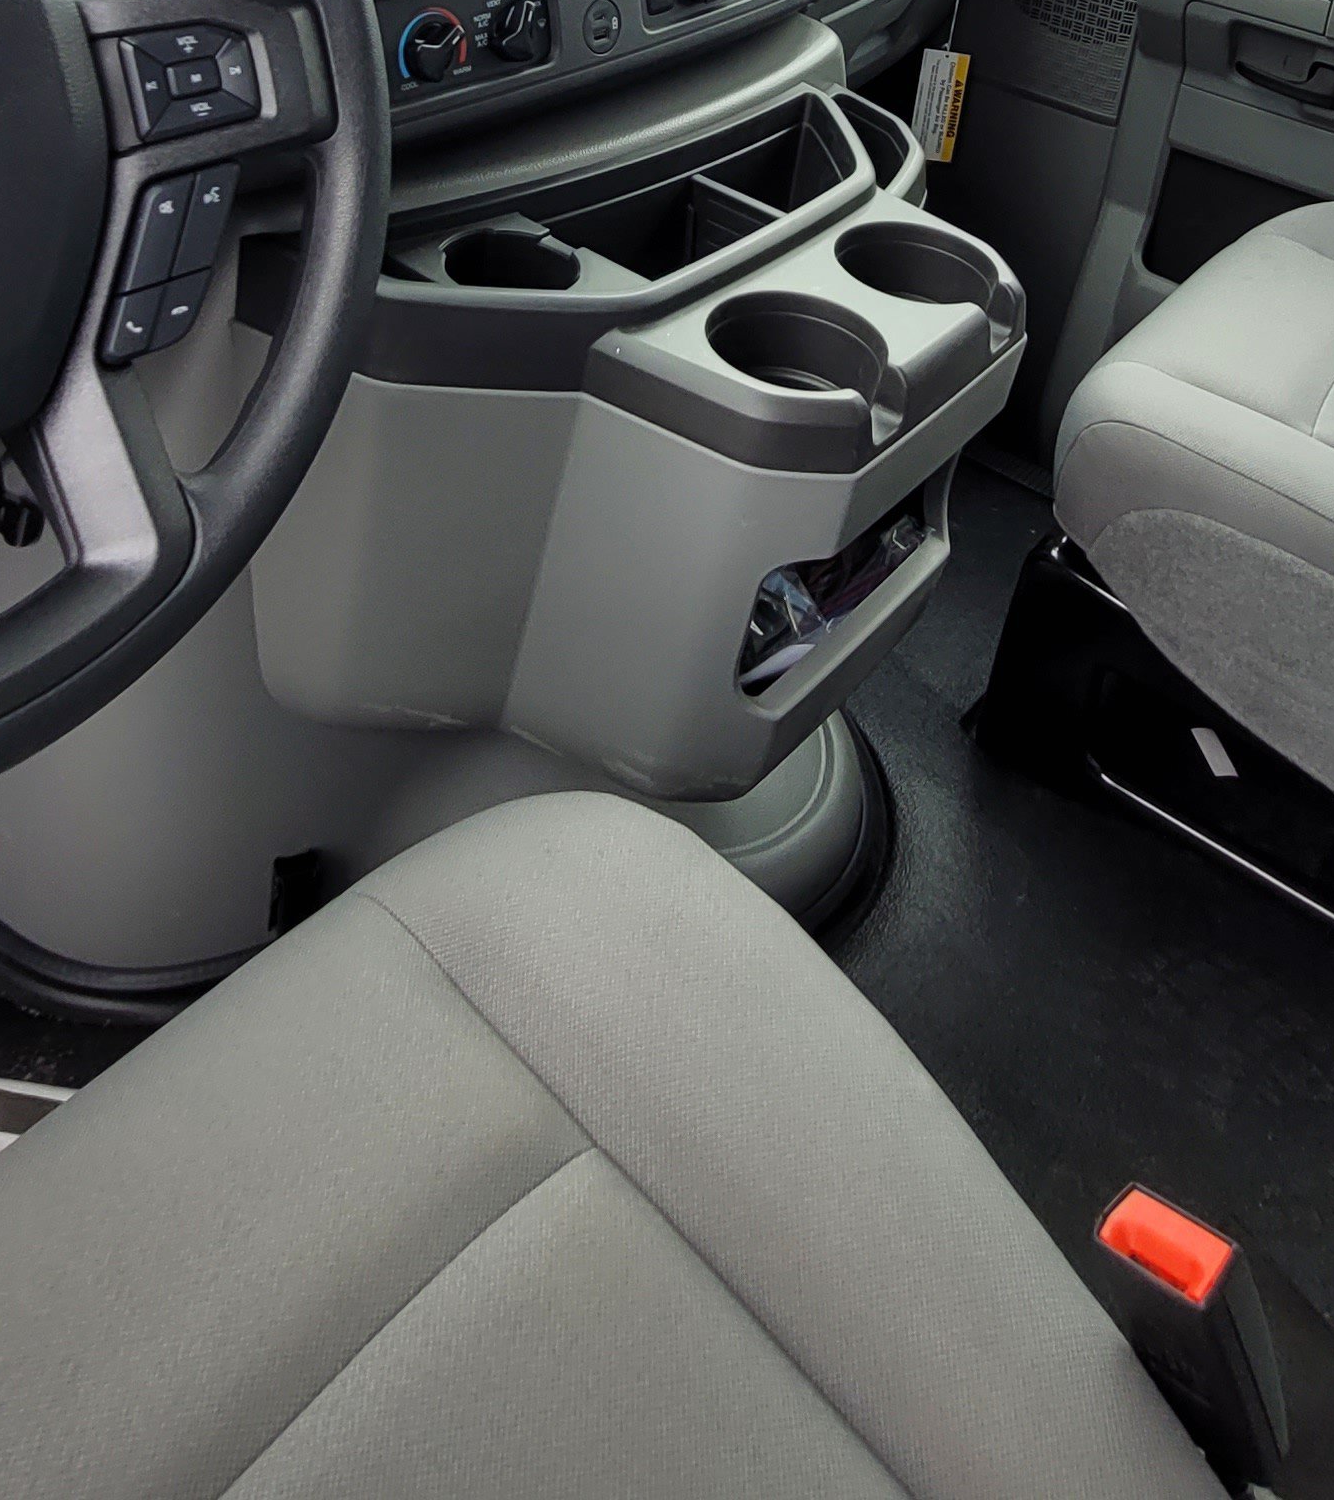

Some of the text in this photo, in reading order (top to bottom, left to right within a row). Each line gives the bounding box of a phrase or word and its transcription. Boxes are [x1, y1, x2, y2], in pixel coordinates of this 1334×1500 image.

[473, 12, 492, 24] NORM
[400, 82, 419, 92] COOL
[945, 88, 963, 139] WARNING
